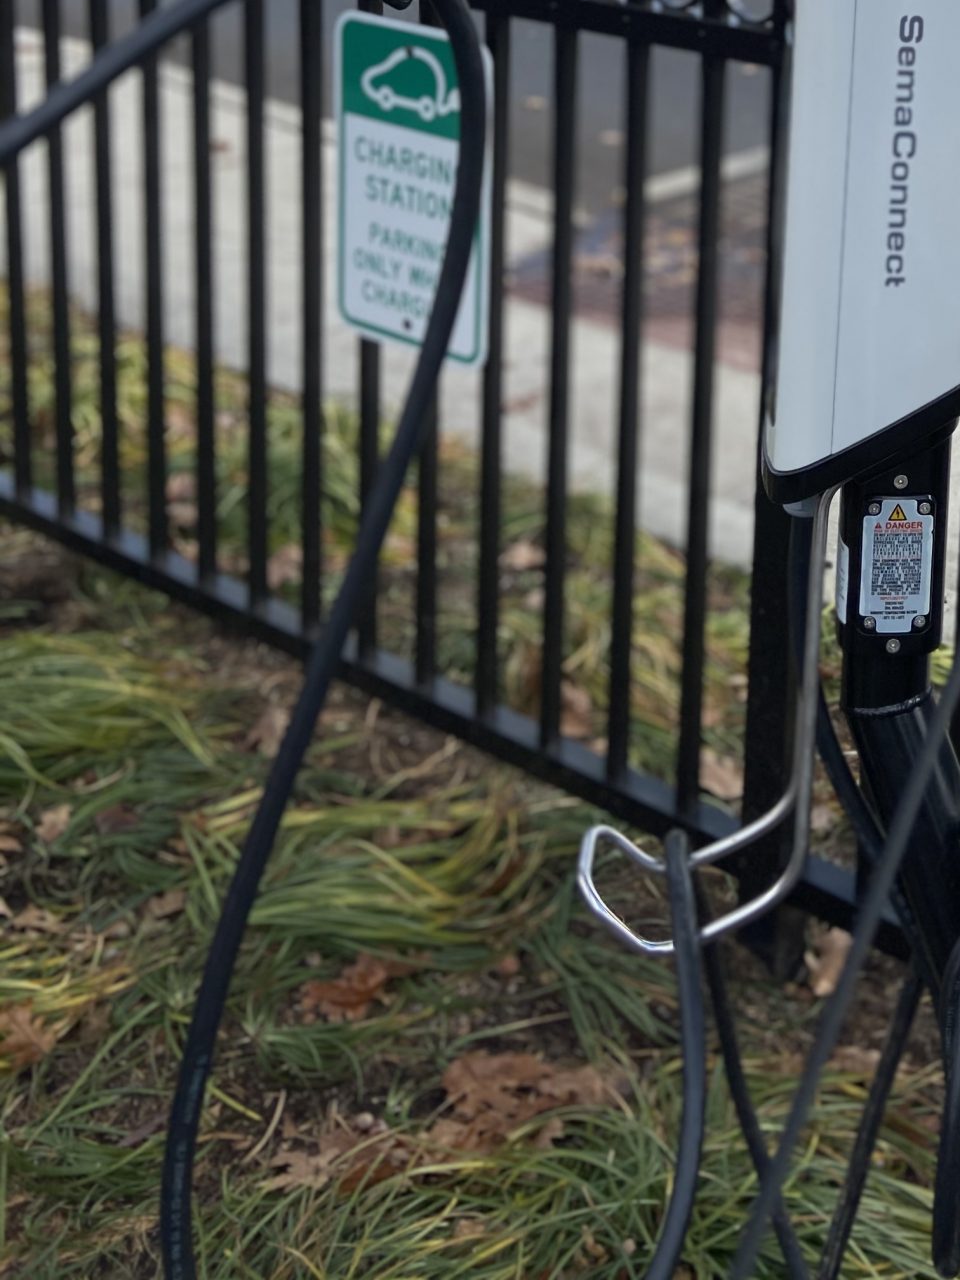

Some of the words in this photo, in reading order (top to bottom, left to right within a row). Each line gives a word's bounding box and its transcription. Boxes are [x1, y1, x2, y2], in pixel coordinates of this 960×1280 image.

[354, 135, 452, 184] CHARGIN
[885, 15, 924, 287] SemaConnect
[885, 521, 923, 529] DANGER
